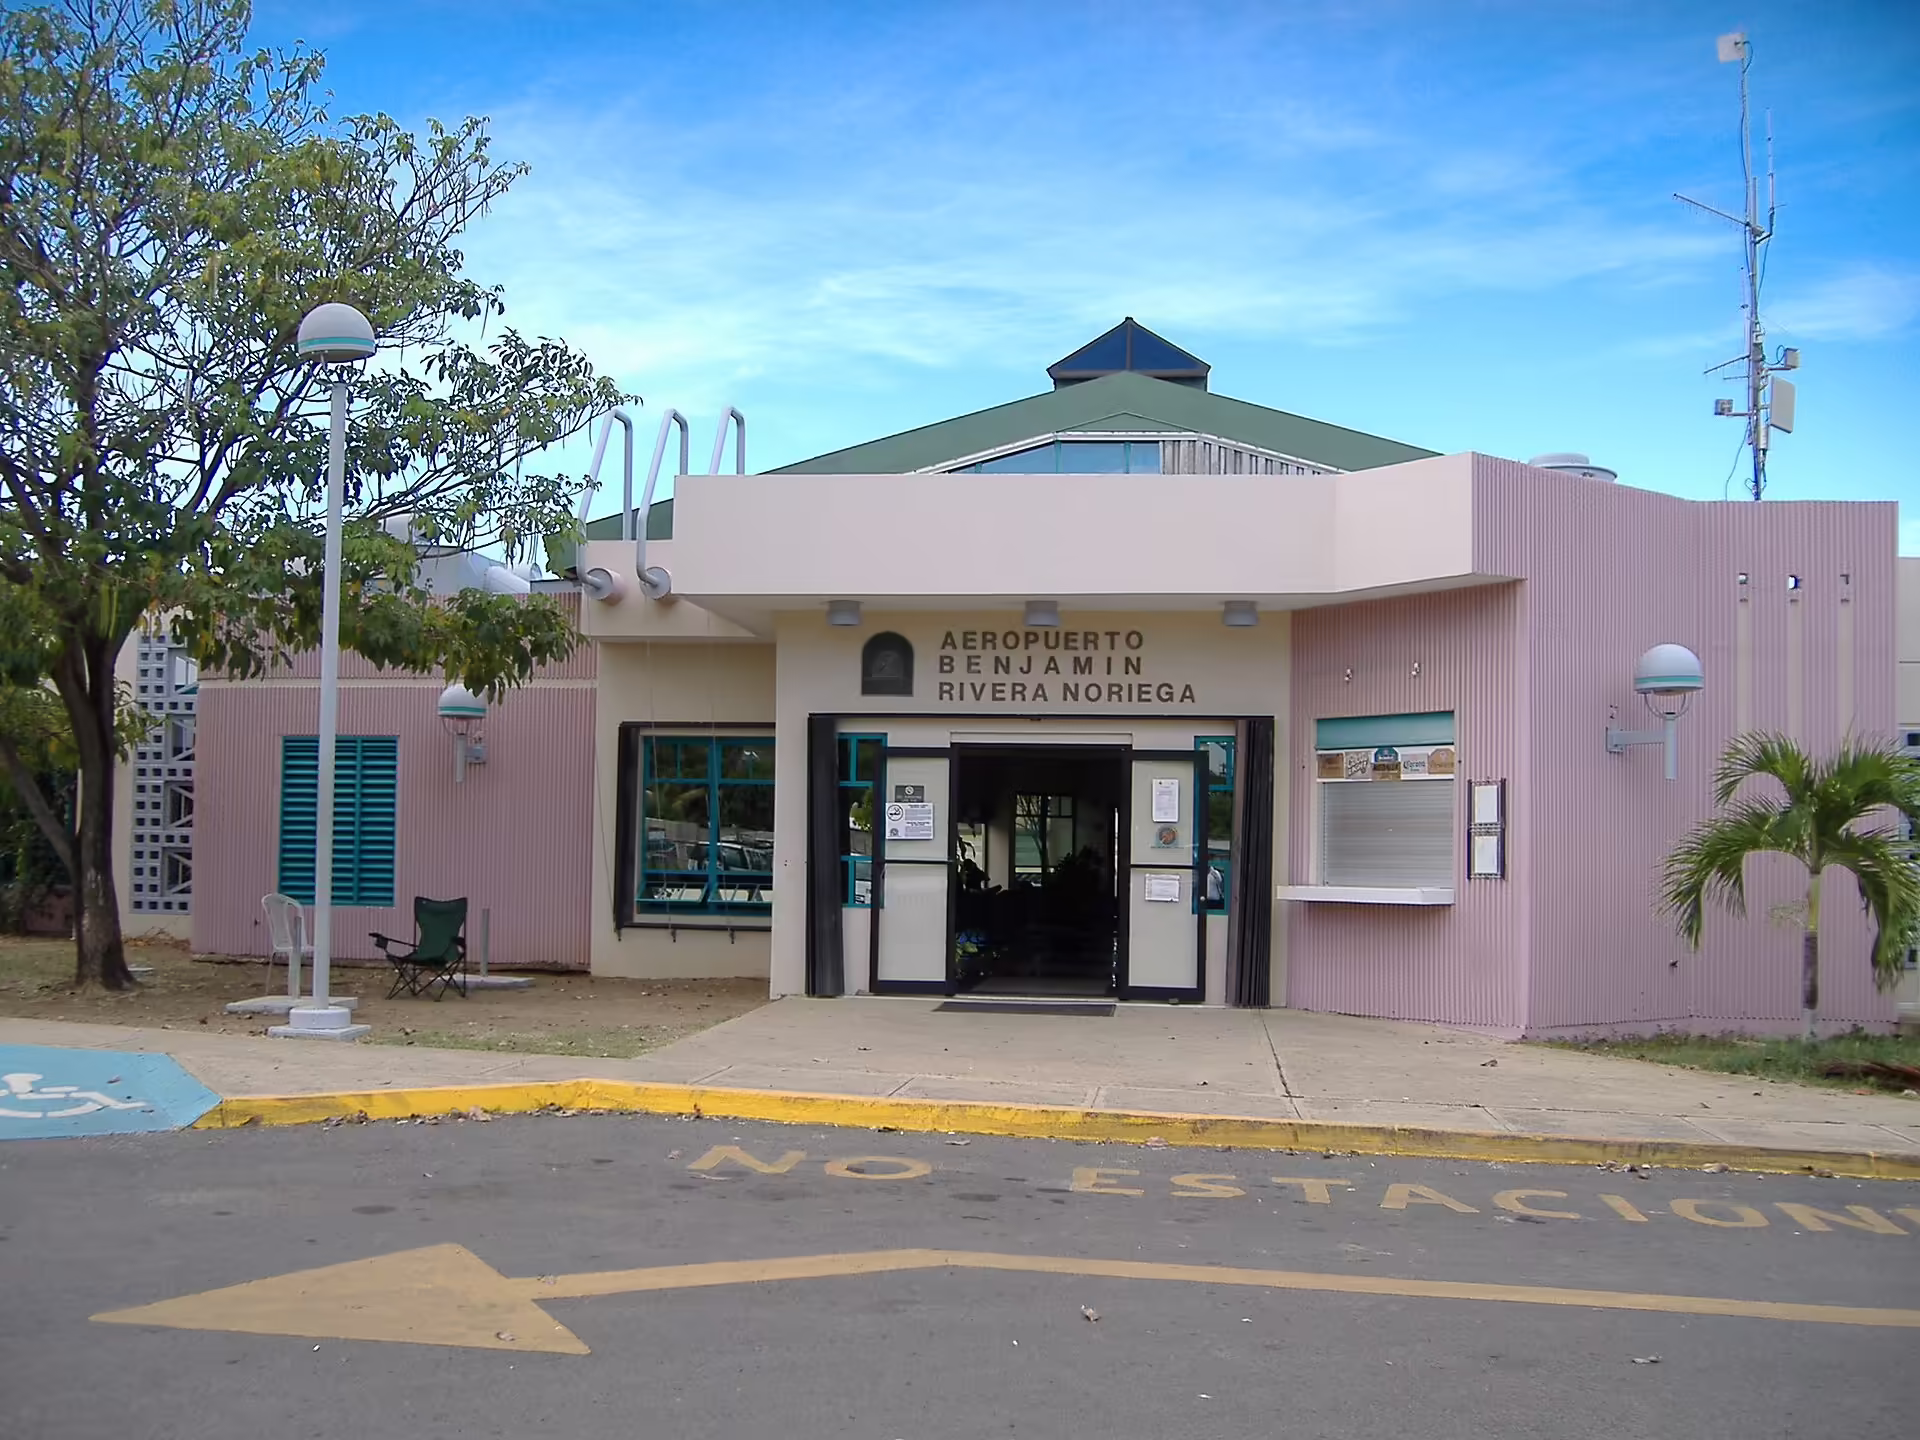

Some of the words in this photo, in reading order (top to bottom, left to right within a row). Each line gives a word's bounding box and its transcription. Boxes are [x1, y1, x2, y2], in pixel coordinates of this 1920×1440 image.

[940, 631, 1144, 651] AEROPUERTO
[938, 655, 1142, 675] BENJAMIN
[938, 682, 1049, 702] RIVERA
[1062, 683, 1196, 704] NORIEGA
[686, 1145, 932, 1180] NO
[1070, 1166, 1920, 1235] ESTACION
